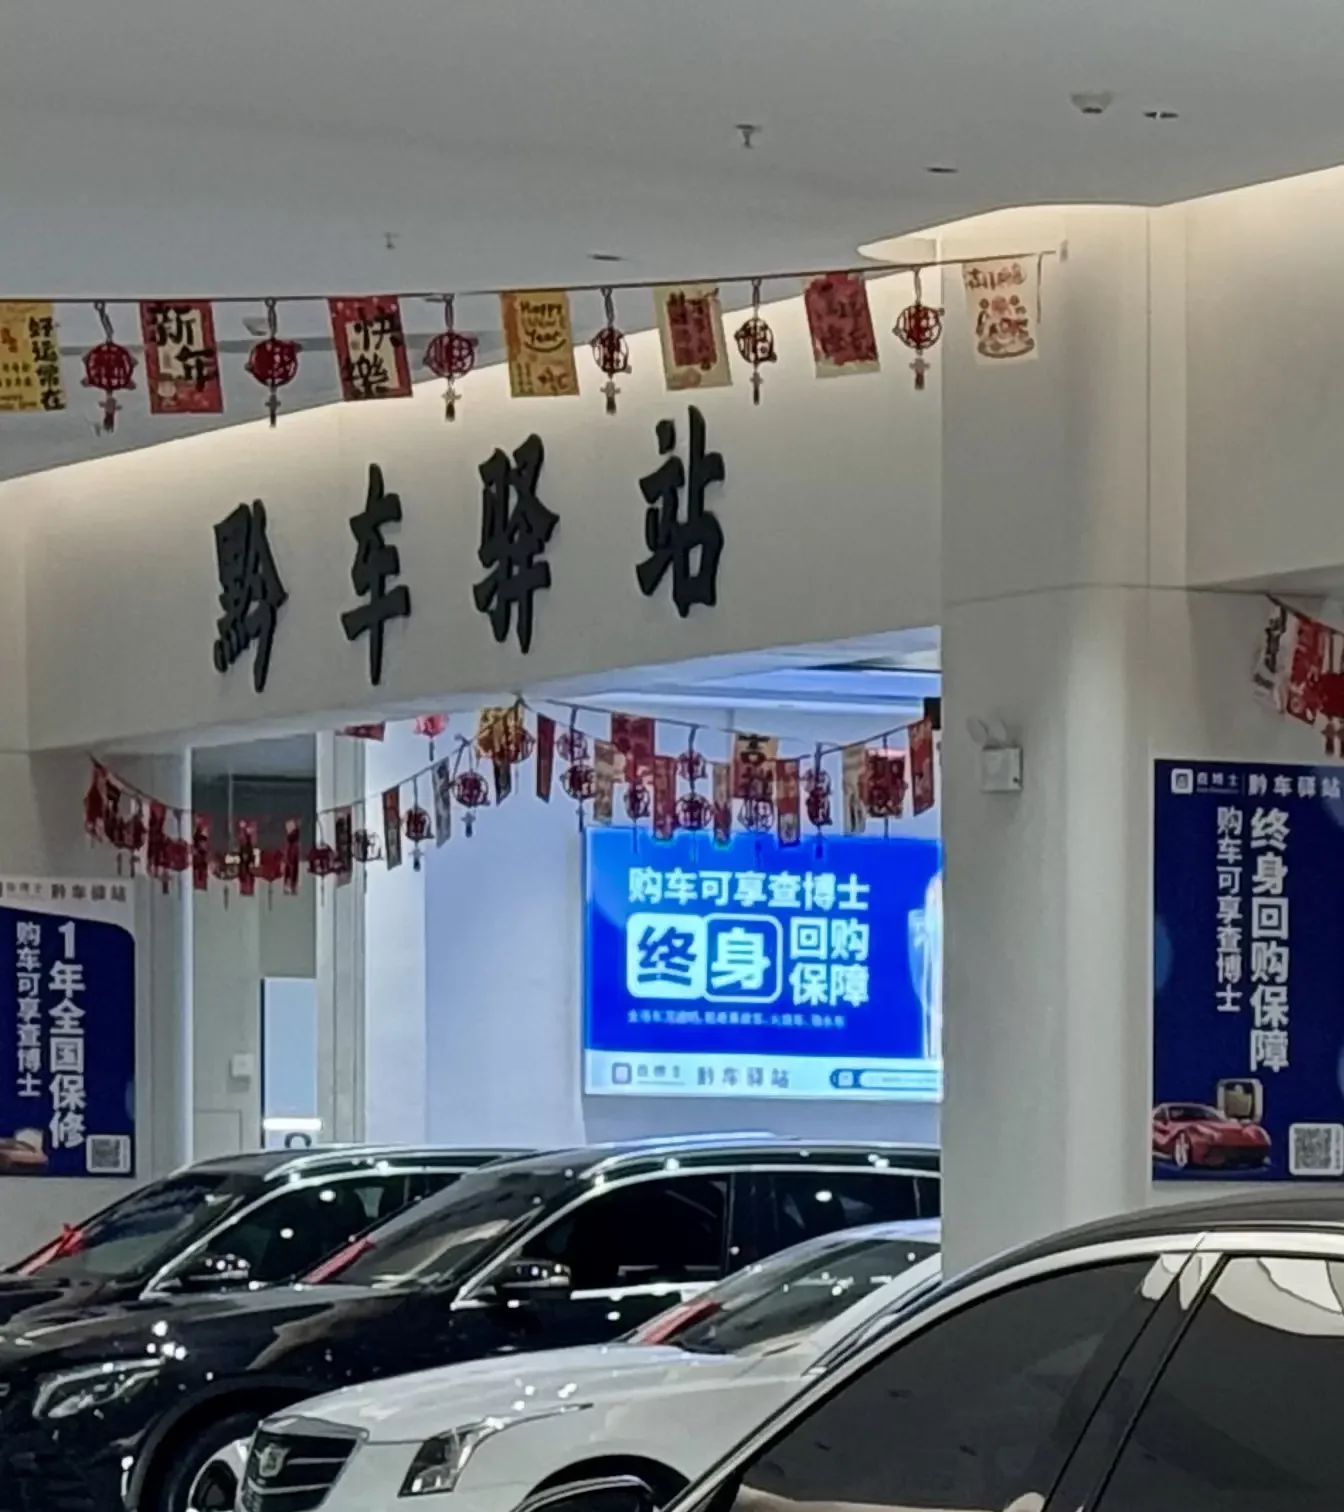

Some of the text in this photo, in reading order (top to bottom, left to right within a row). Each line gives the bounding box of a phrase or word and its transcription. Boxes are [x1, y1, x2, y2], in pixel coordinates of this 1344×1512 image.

[213, 405, 725, 692] 黔车驿站
[628, 866, 870, 910] 购车可享查博士
[637, 924, 771, 990] 终身
[790, 916, 869, 961] 回购
[1216, 806, 1243, 1012] 购车可享查博士
[1250, 807, 1290, 1073] 终身回购保障
[16, 921, 41, 1097] 购车可享查博士
[49, 921, 86, 1149] 1年全国保修
[789, 963, 869, 1007] 保障
